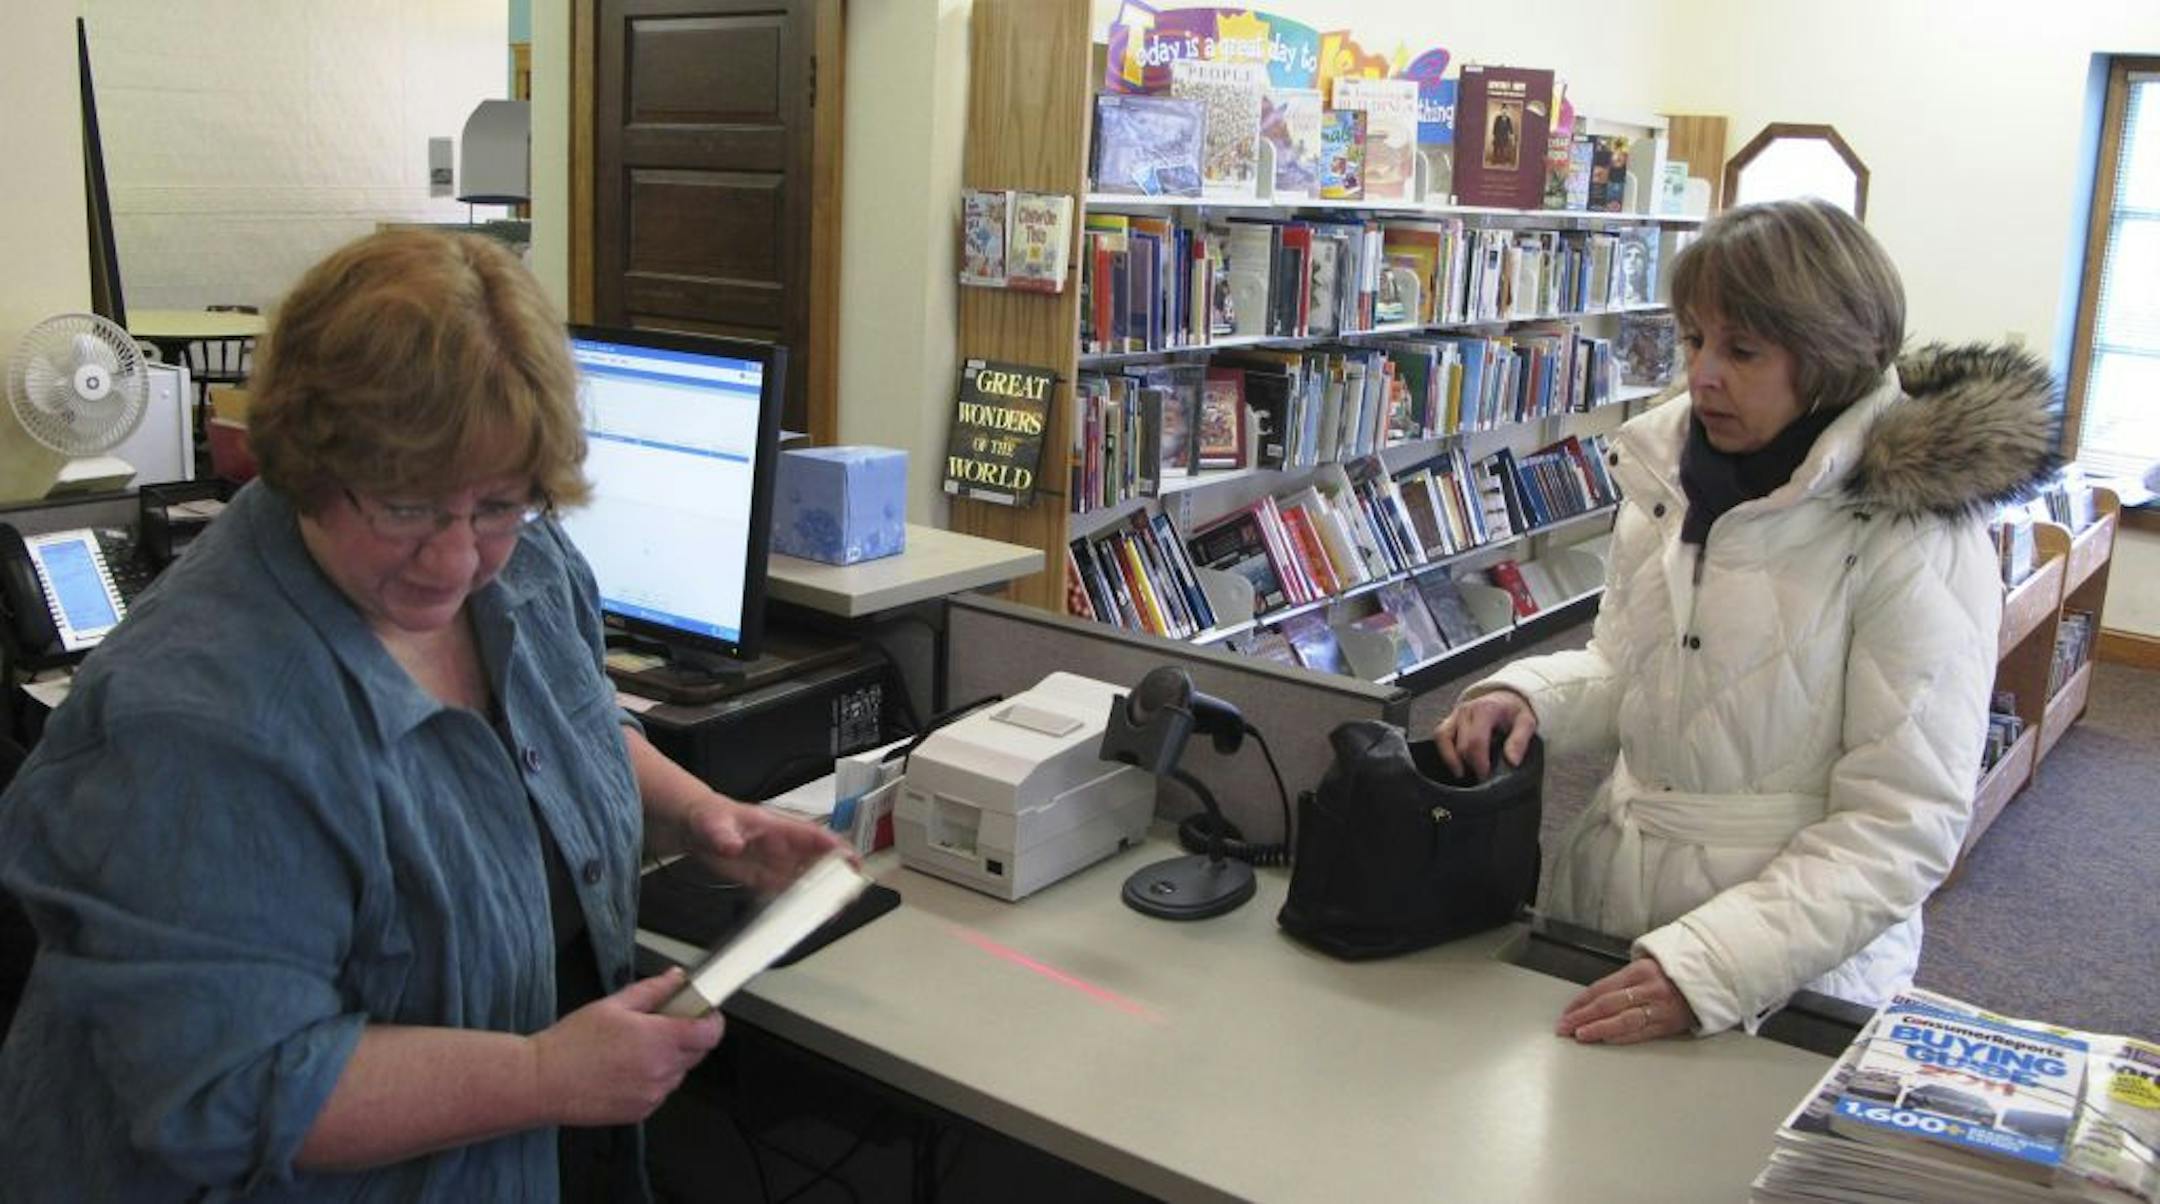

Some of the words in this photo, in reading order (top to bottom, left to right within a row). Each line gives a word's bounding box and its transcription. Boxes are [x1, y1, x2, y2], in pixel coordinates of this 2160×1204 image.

[1121, 3, 1181, 86] Today
[1185, 31, 1199, 57] is
[1204, 39, 1215, 56] a
[1269, 33, 1297, 71] day
[1301, 42, 1318, 72] to
[1188, 65, 1251, 81] PEOPLE
[1418, 97, 1454, 129] thing
[977, 370, 1049, 400] GREAT
[958, 401, 1042, 435] WONDERS
[973, 437, 989, 452] OF
[991, 440, 1016, 458] THE
[949, 456, 1033, 490] WORLD
[1890, 1025, 2067, 1077] BUYING
[1905, 1044, 2039, 1087] GUIDE
